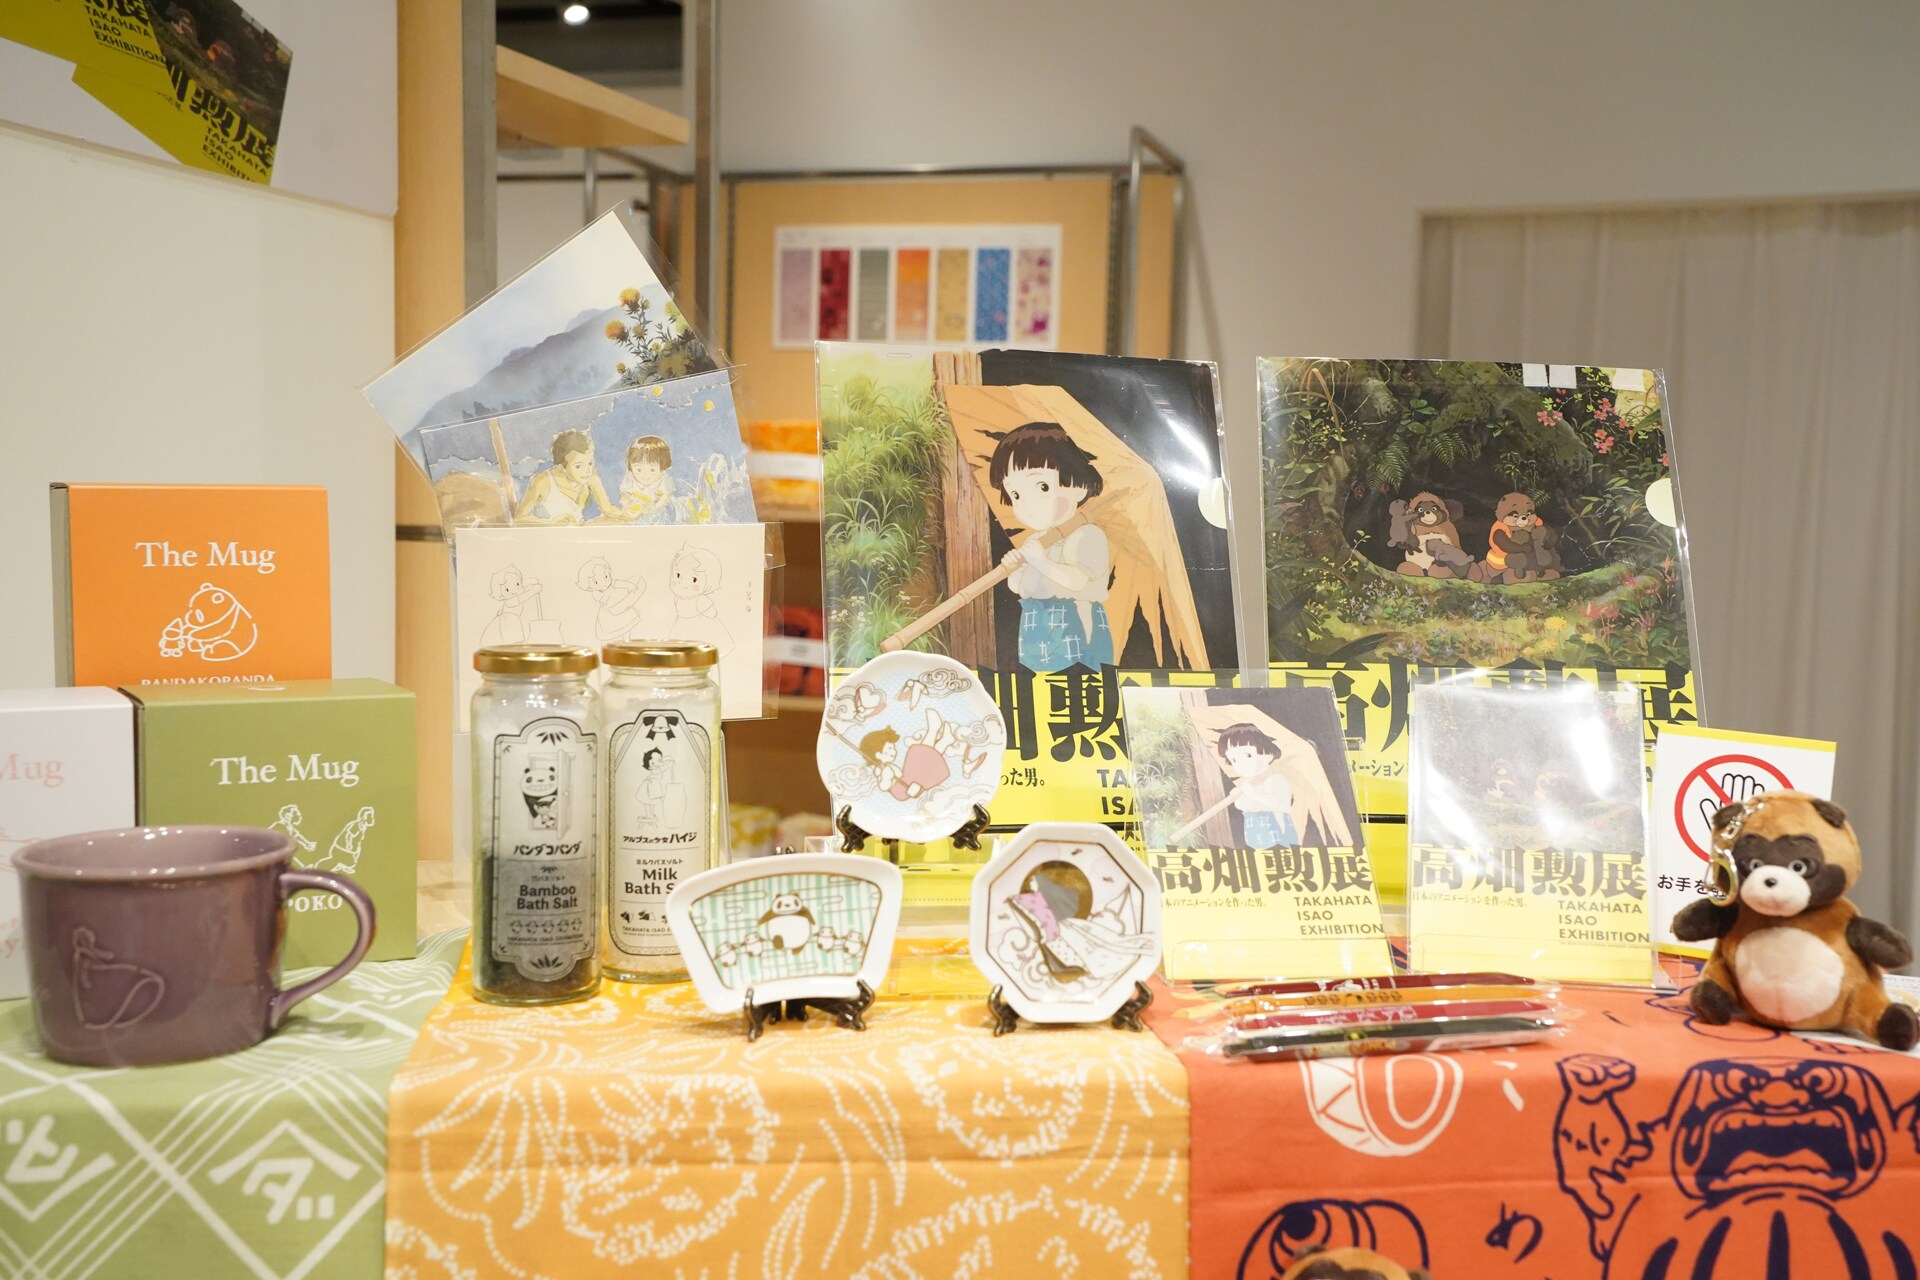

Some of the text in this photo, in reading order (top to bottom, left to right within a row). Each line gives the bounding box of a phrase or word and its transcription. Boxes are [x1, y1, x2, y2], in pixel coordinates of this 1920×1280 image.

[84, 5, 152, 39] TAKAHATA
[89, 18, 121, 36] ISAO
[204, 136, 234, 160] ISAO
[206, 126, 267, 177] TAKAHATA
[134, 541, 276, 575] The Mug
[210, 753, 360, 788] The Mug
[623, 831, 697, 844] アルプスの少女ハイジ
[513, 841, 583, 856] パンダコパンダ
[636, 858, 684, 866] ミルクバスソルト
[1152, 842, 1373, 895] 高畑勲展
[642, 867, 678, 881] Milk
[1412, 842, 1648, 901] 高畑勲展
[519, 884, 577, 897] Bamboo
[624, 882, 661, 895] Bath
[516, 896, 579, 910] Bath Salt
[1294, 895, 1373, 907] TAKAHATA
[1558, 899, 1643, 914] TAKAHATA
[1297, 910, 1333, 921] ISAO
[1558, 914, 1598, 926] ISAO
[1300, 924, 1384, 936] EXHIBITION
[1559, 928, 1650, 943] EXHIBITION
